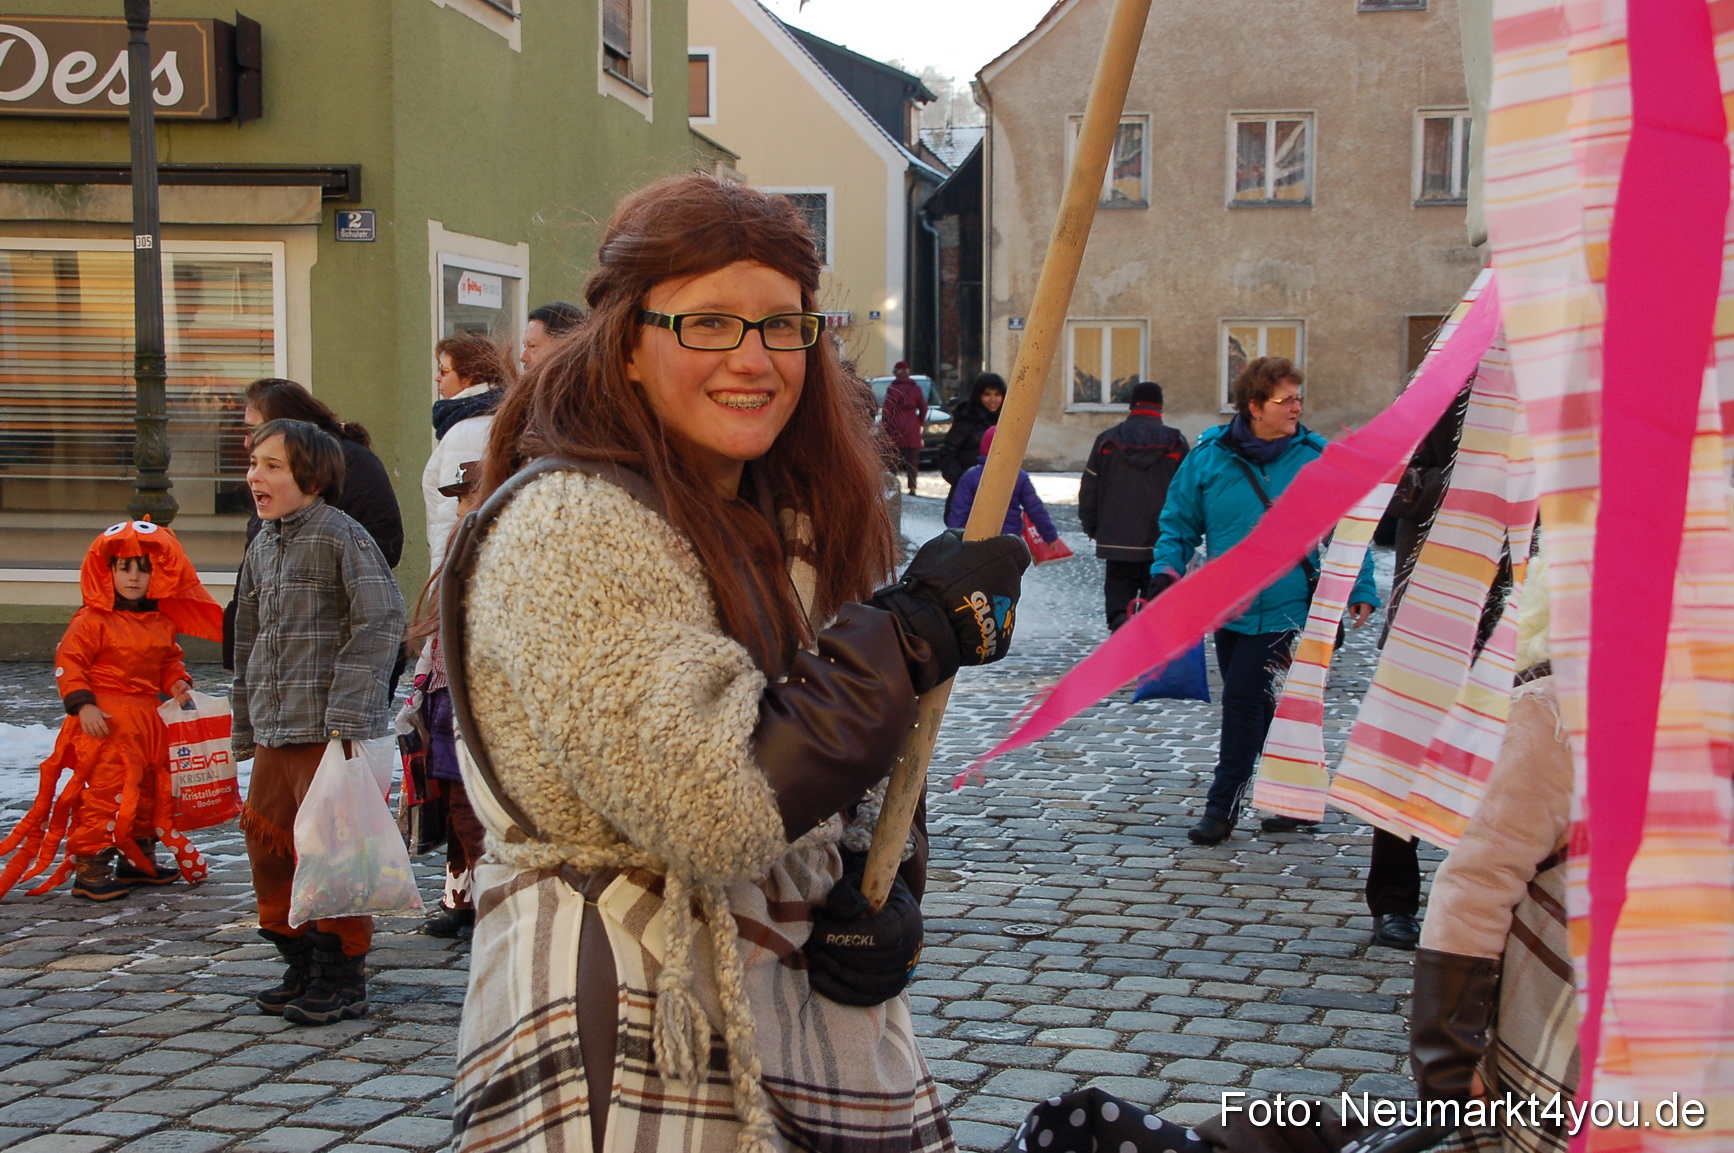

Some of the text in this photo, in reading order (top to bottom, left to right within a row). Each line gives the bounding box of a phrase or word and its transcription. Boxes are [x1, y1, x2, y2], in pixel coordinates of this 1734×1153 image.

[348, 211, 362, 228] 2
[136, 236, 152, 248] 305
[826, 933, 876, 946] ROECKL
